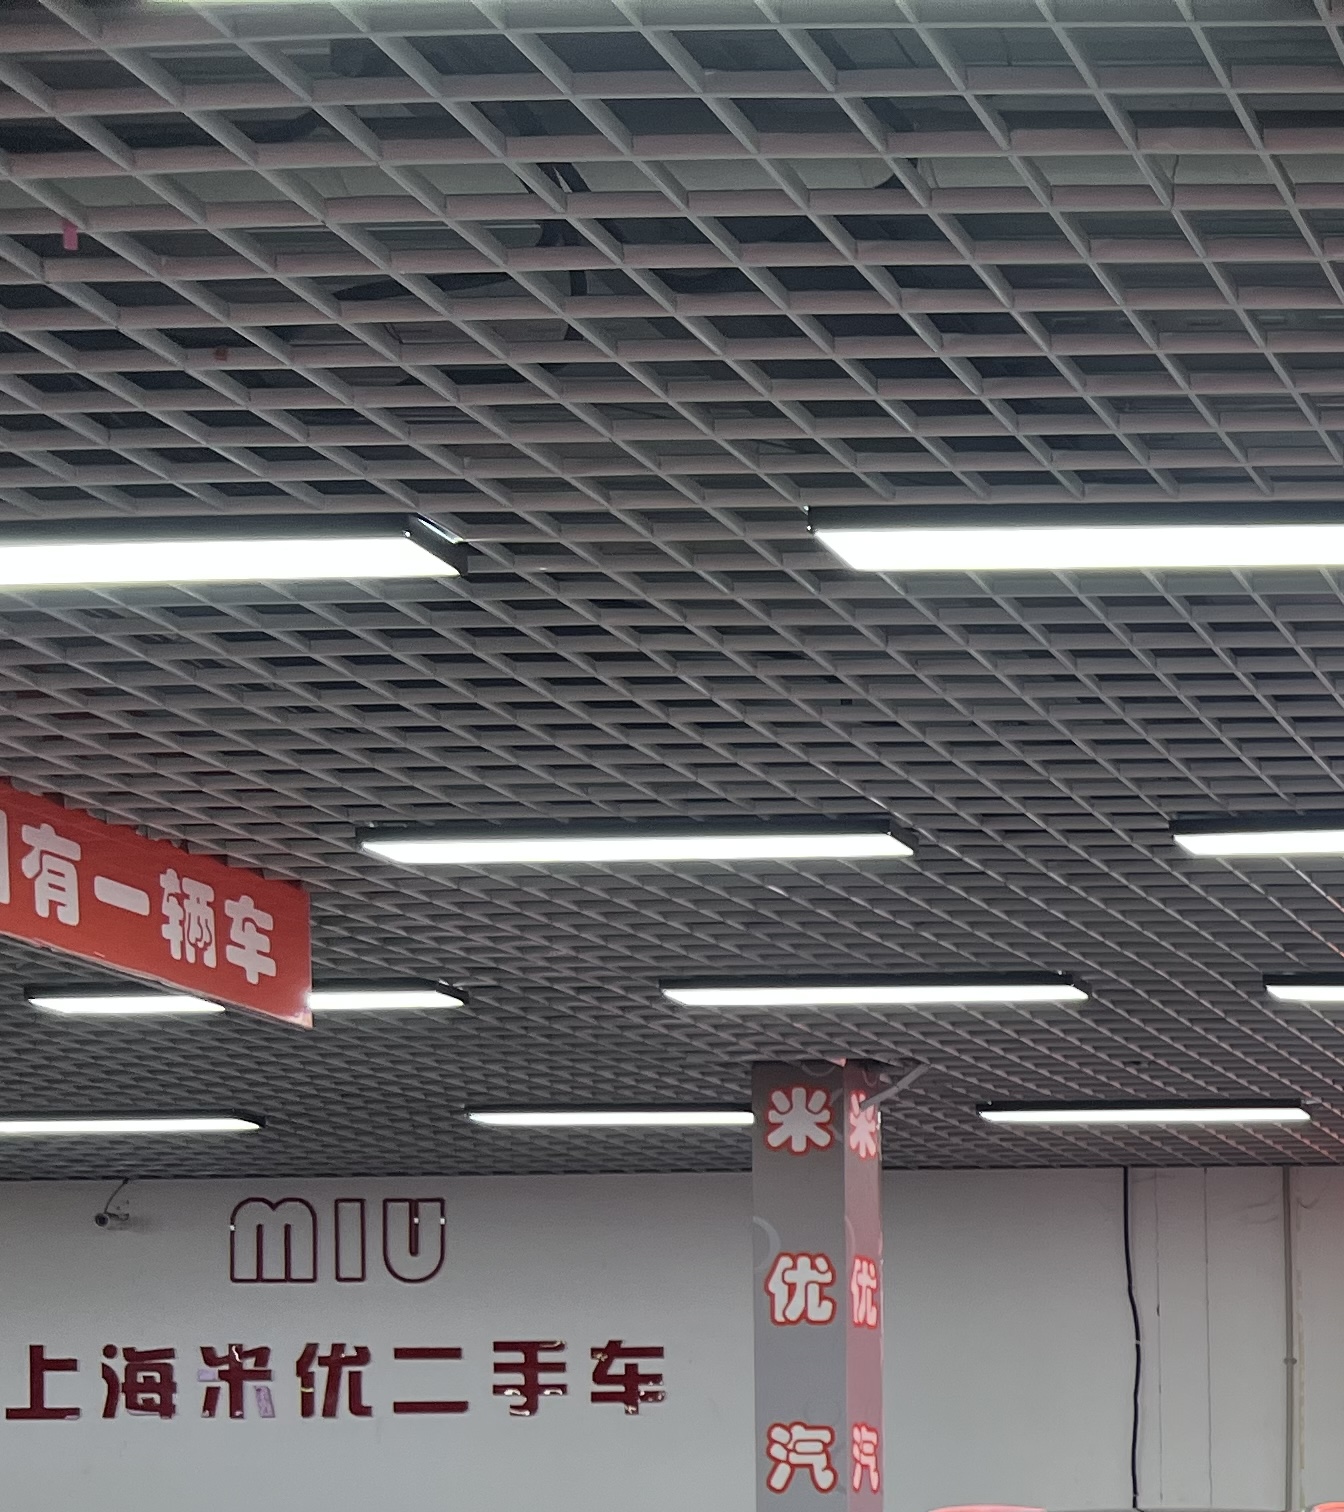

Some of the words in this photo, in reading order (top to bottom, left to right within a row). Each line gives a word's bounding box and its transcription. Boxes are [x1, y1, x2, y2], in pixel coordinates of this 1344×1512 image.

[0, 810, 277, 984] 有一辆车
[6, 1341, 665, 1420] 上海米优二手车
